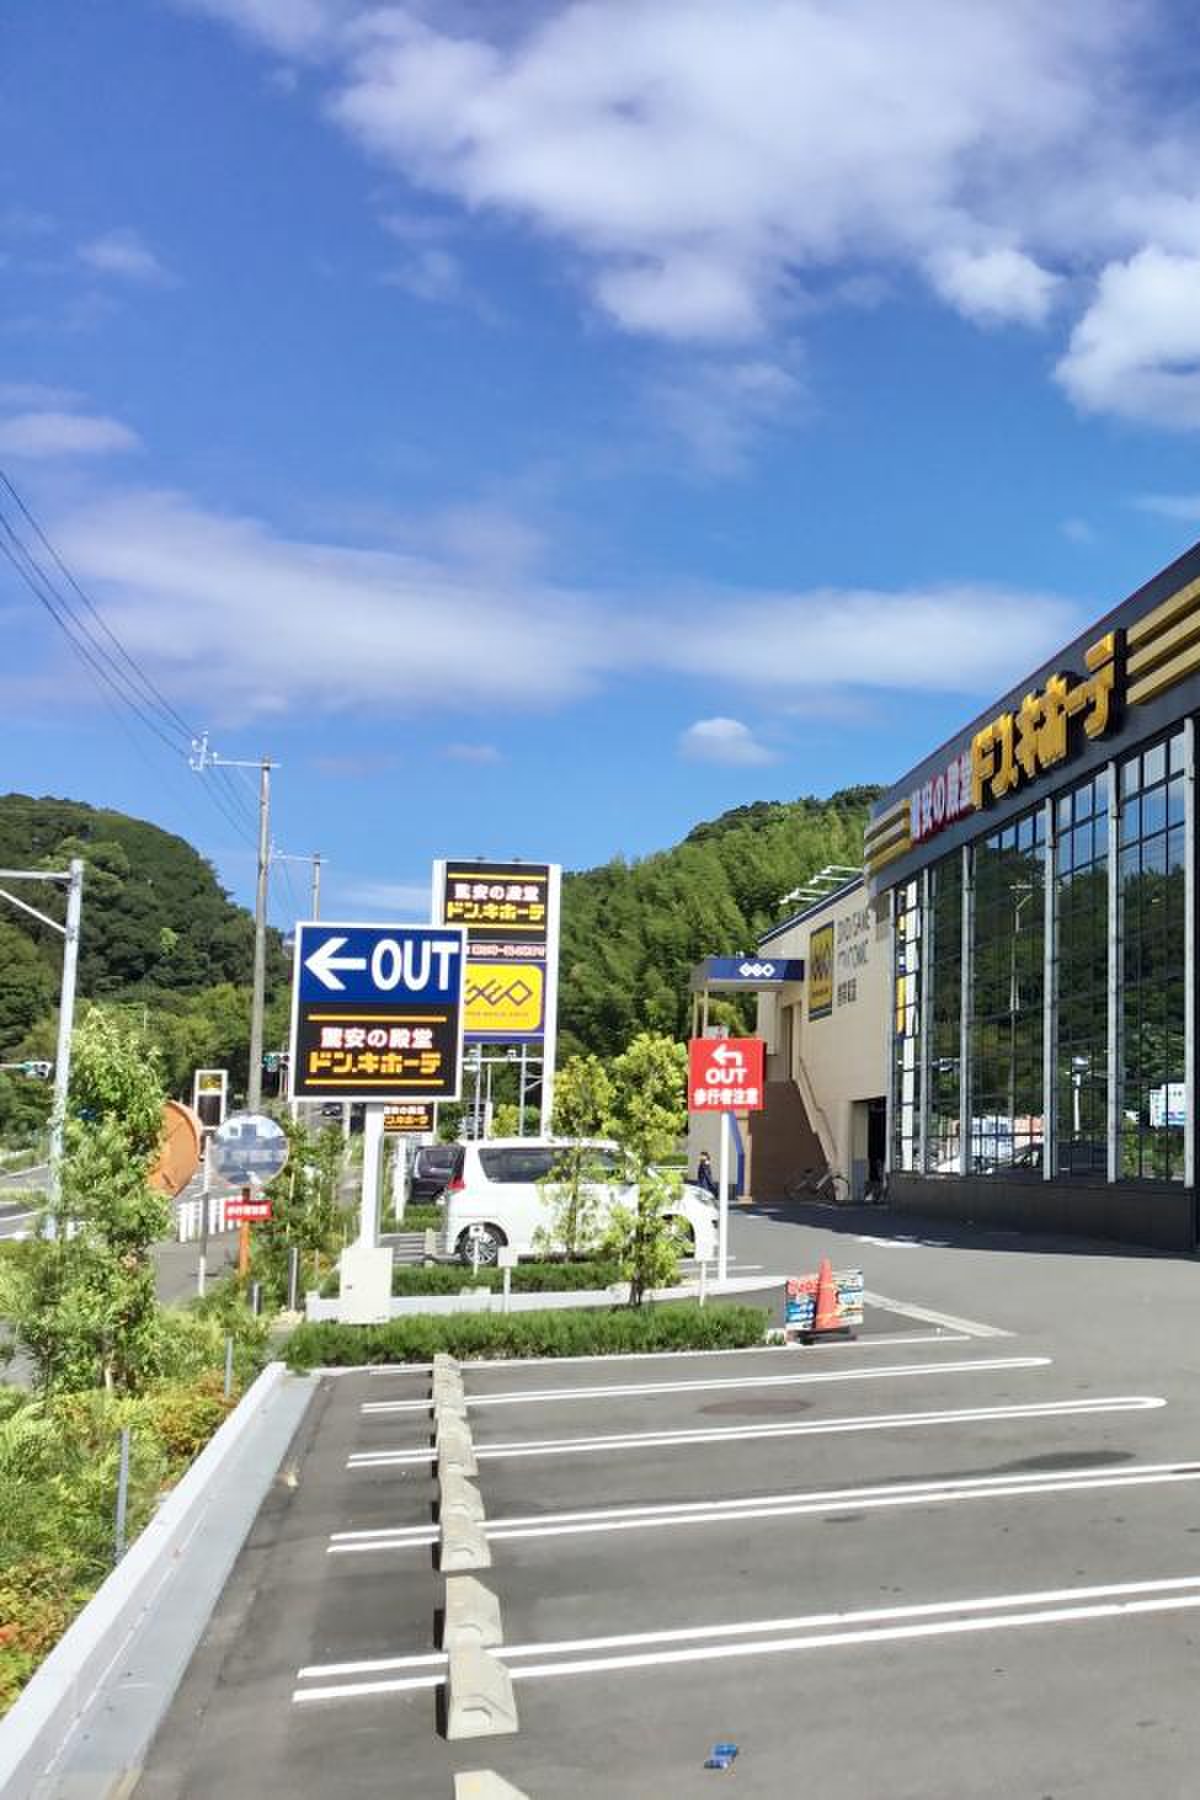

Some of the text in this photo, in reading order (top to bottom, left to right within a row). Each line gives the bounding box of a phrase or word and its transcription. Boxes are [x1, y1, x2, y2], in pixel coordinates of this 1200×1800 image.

[371, 938, 460, 991] OUT
[705, 1067, 748, 1085] OUT
[693, 1087, 759, 1106] 歩行者注意
